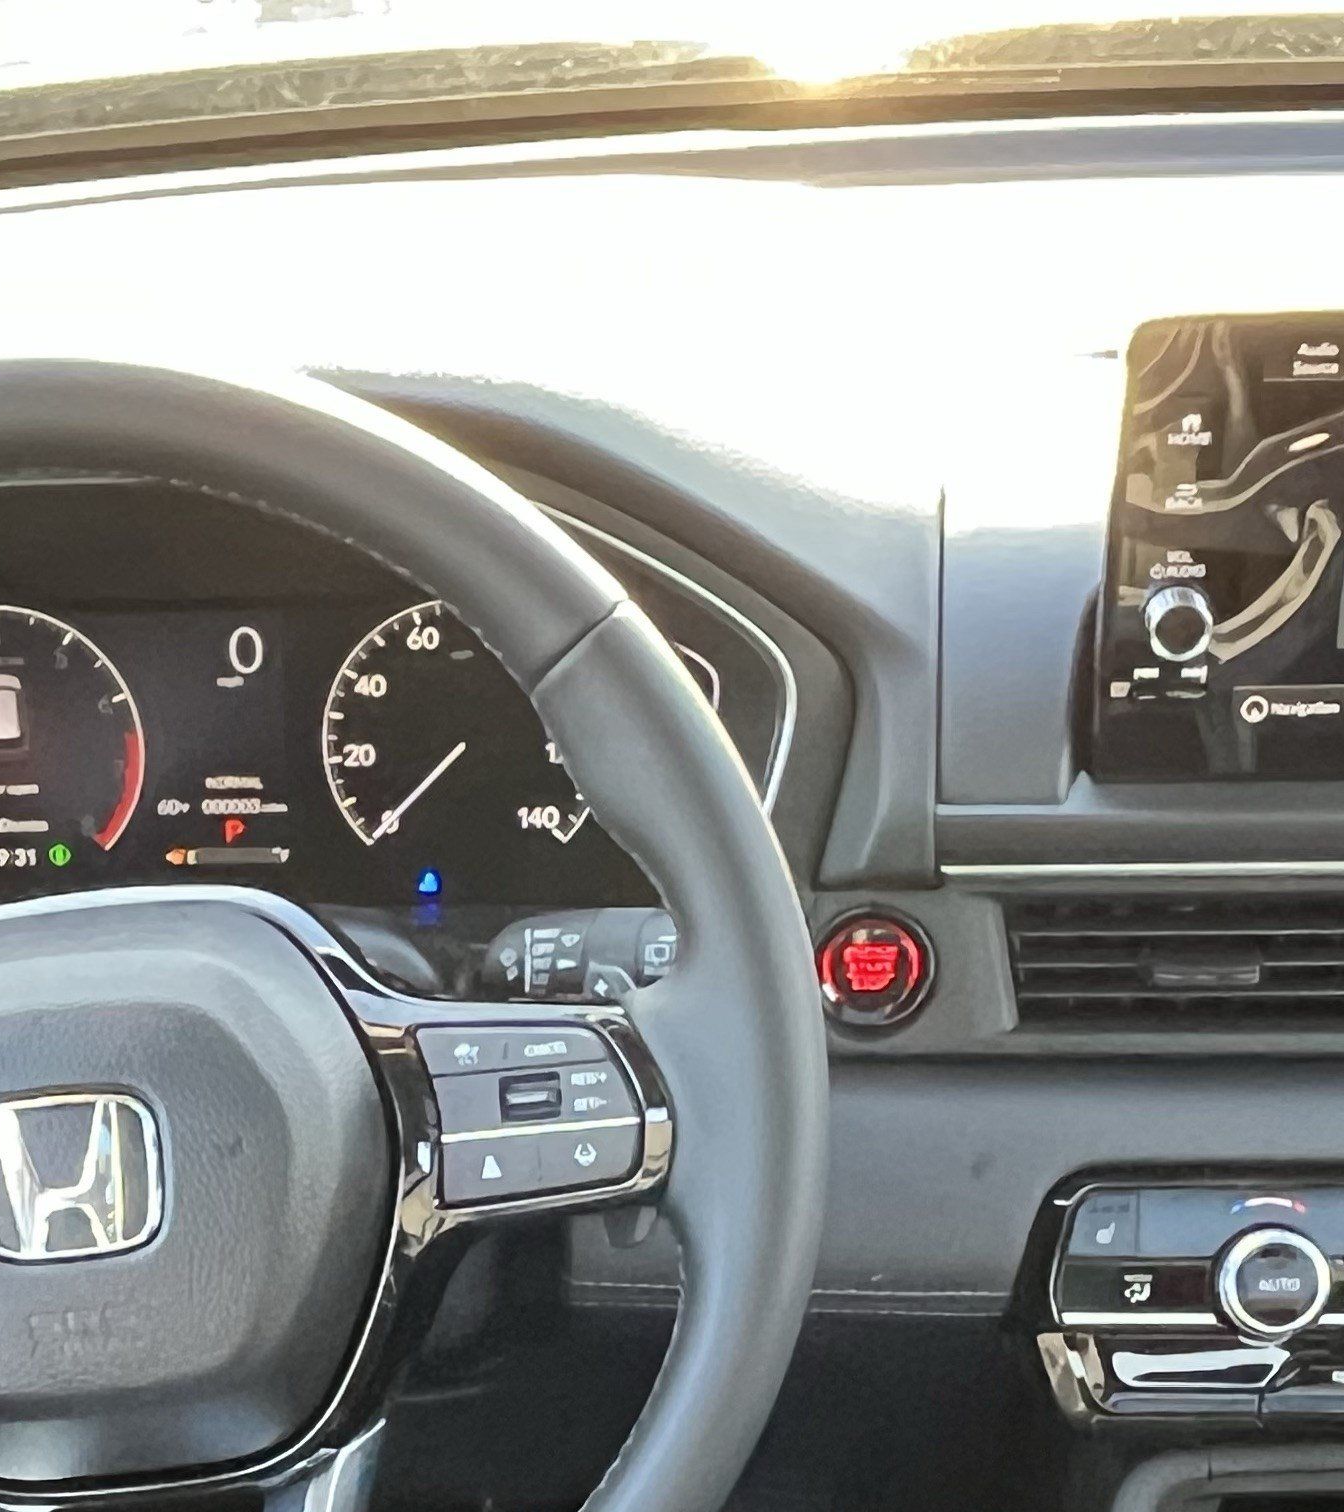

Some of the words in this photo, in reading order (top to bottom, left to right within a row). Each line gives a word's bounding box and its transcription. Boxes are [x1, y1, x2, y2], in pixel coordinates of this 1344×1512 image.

[228, 626, 263, 675] 0
[407, 626, 441, 651] 60
[354, 673, 388, 698] 40
[342, 743, 377, 767] 20
[517, 805, 560, 829] 140
[225, 819, 246, 843] P
[1258, 1277, 1302, 1292] AUTO
